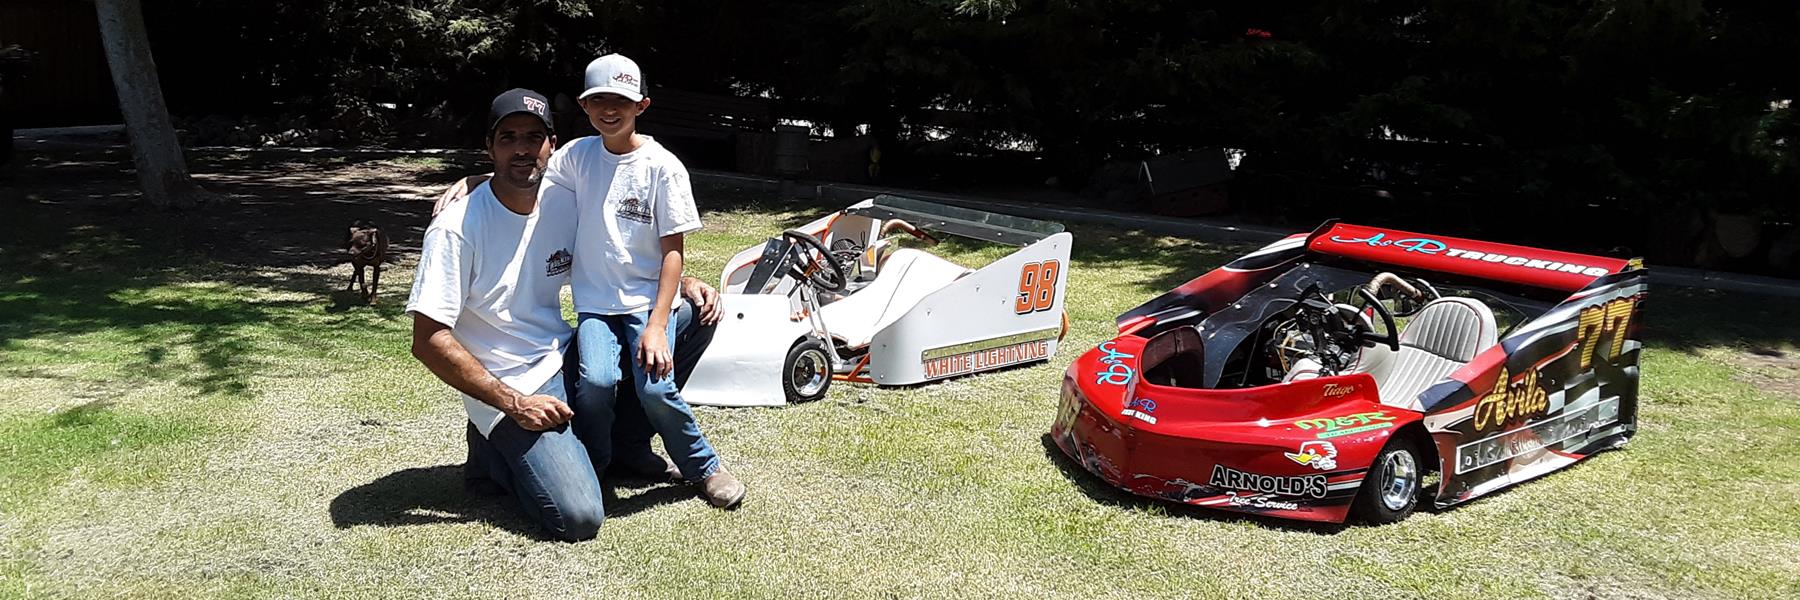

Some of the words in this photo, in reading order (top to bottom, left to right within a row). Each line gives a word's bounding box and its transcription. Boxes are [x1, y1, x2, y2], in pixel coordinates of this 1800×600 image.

[523, 96, 546, 116] 77
[1445, 248, 1609, 277] TRUCKING
[1015, 259, 1060, 315] 98
[1577, 297, 1636, 368] 77
[924, 354, 973, 379] WHITE
[973, 340, 1049, 370] LIGHTNING
[1323, 383, 1354, 398] Tiago
[1473, 366, 1549, 431] Avila
[1294, 412, 1397, 431] M&R
[1210, 464, 1328, 499] ARNOLD'S
[1226, 491, 1257, 507] Tree
[1254, 496, 1299, 511] Service
